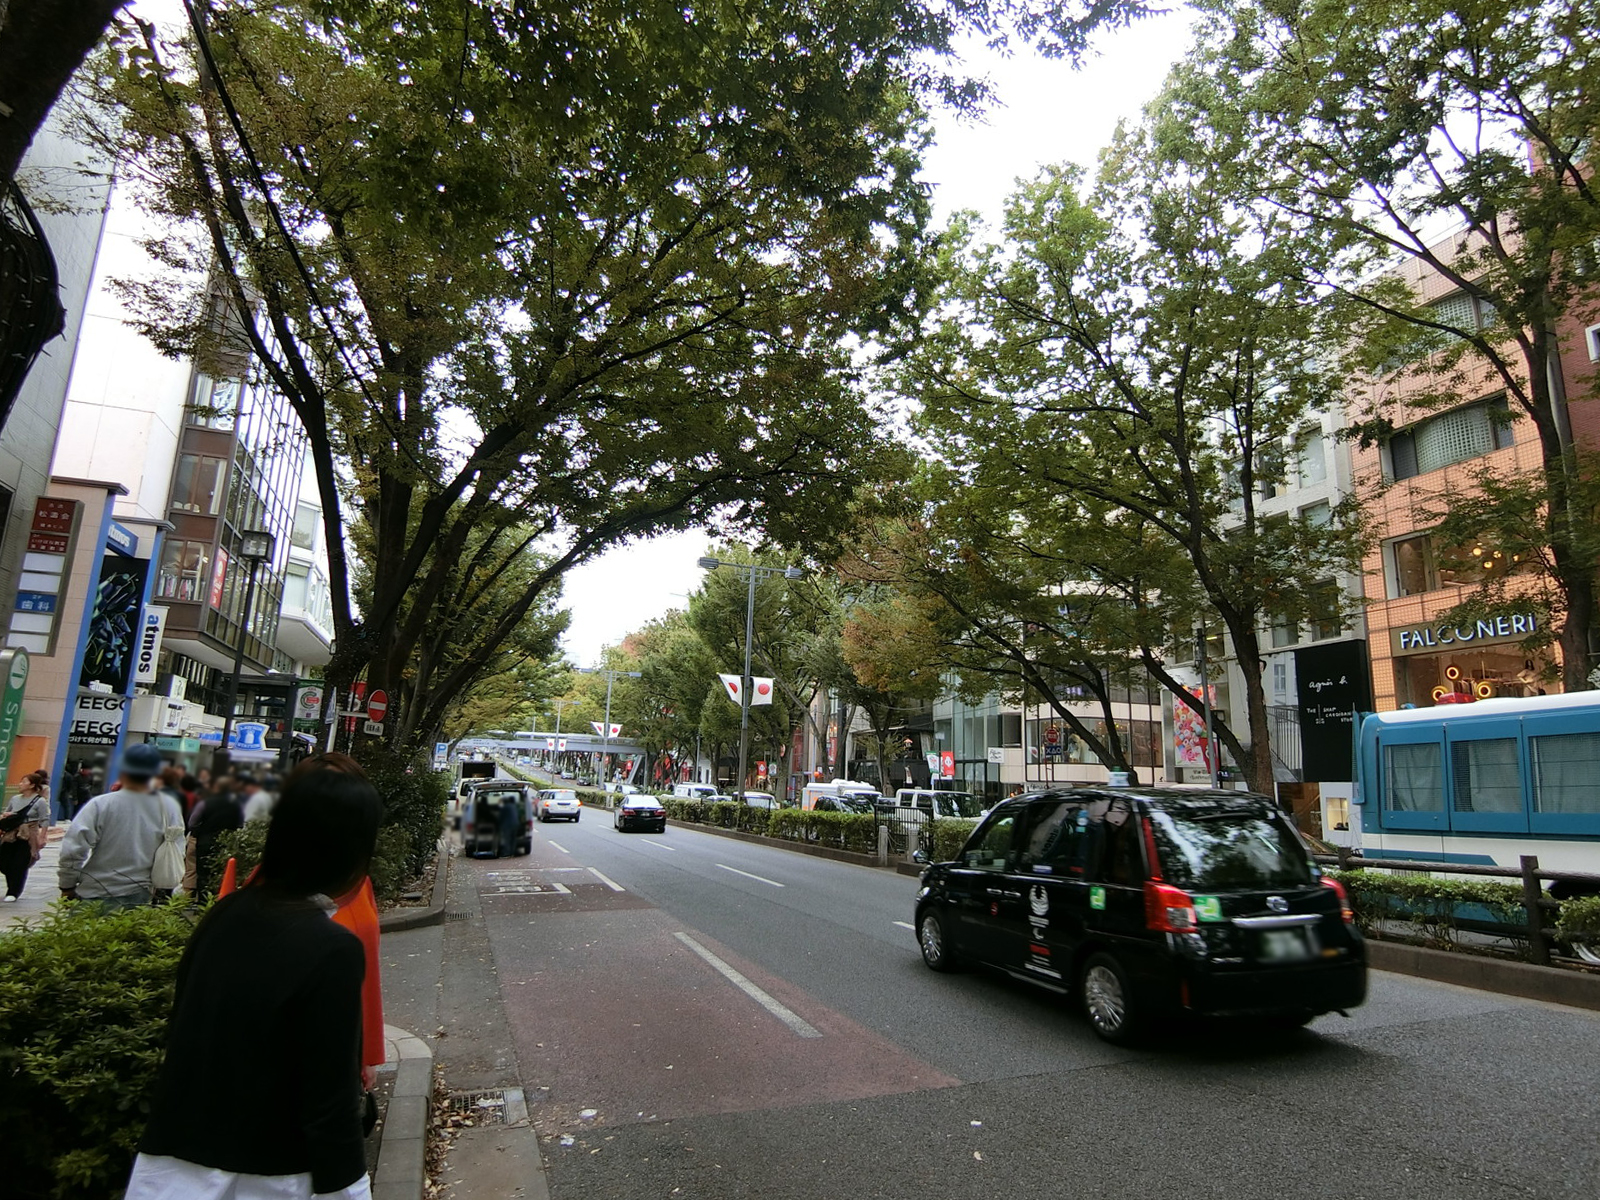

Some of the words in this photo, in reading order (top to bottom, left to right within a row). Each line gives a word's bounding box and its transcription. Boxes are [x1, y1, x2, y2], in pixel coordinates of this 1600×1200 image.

[1399, 612, 1537, 651] FALCONERI
[138, 613, 161, 673] atmos
[89, 679, 114, 695] atmos
[75, 696, 126, 711] EEG
[70, 720, 122, 735] EEG
